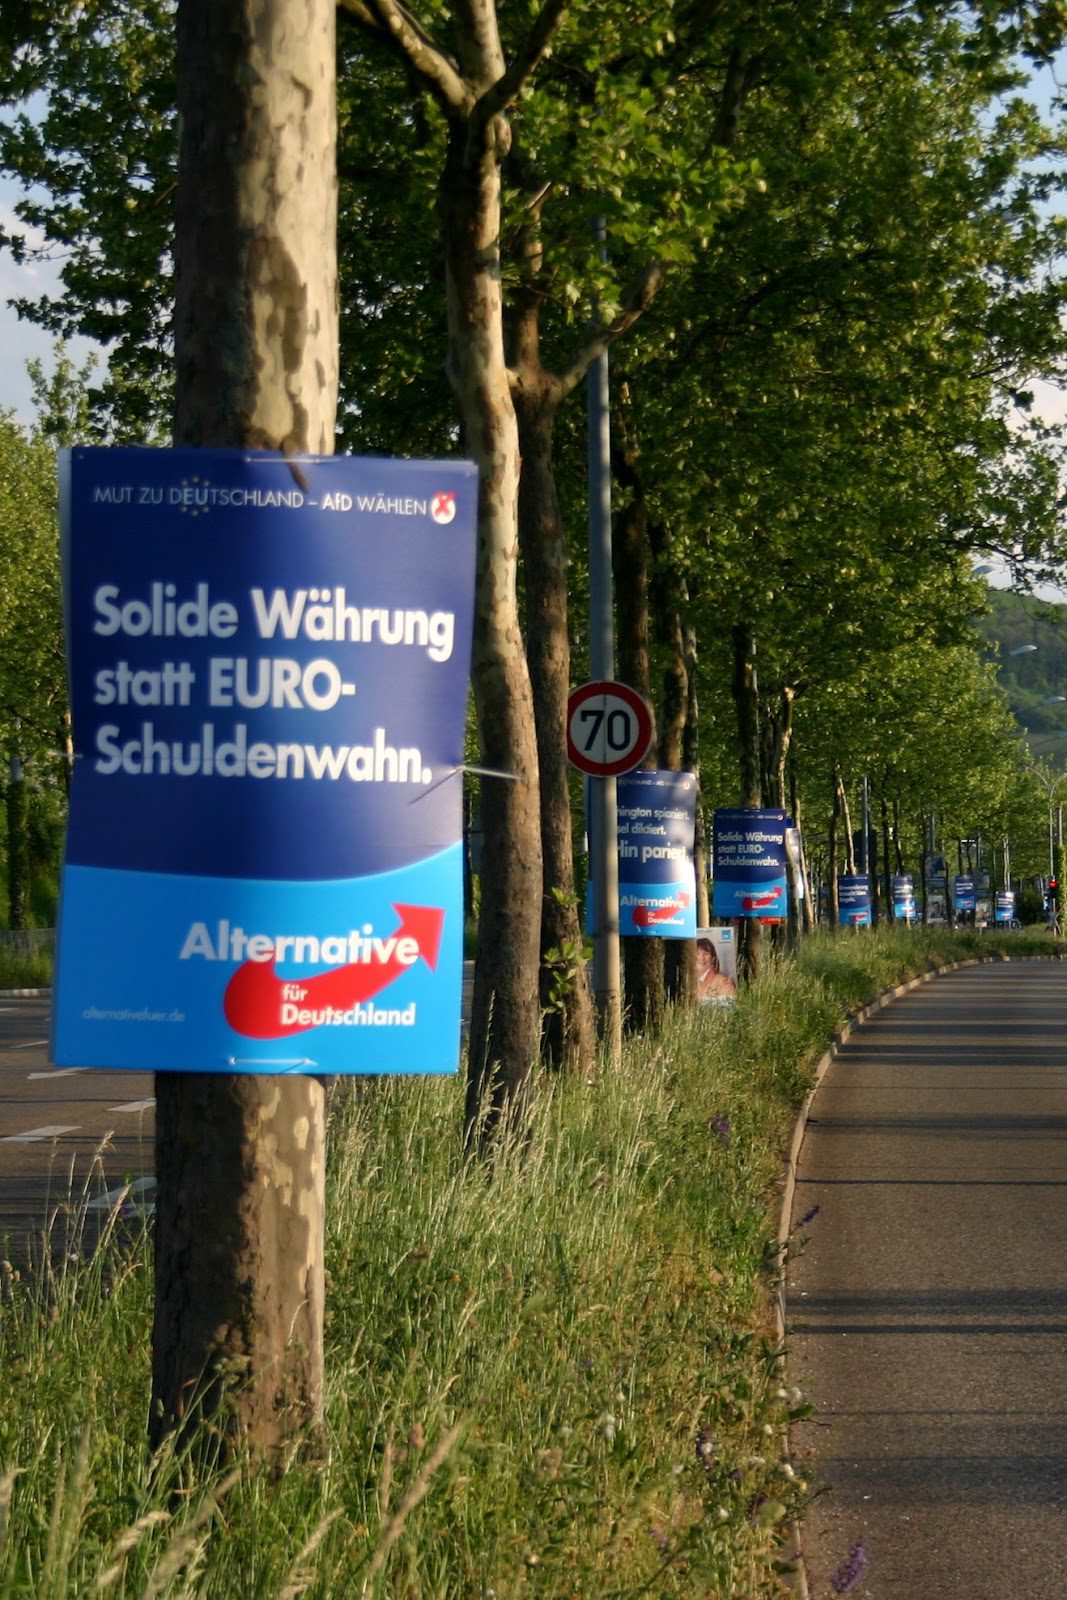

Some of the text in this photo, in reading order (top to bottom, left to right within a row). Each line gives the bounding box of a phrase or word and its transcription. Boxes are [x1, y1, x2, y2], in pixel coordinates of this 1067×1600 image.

[94, 487, 133, 503] MUT
[139, 487, 163, 504] ZU
[169, 487, 304, 508] DEUTSCHLAND
[322, 492, 353, 511] AfD
[357, 492, 426, 516] WÄHLEN
[94, 583, 455, 663] Solide Währung
[94, 657, 356, 711] statt EURO-
[580, 709, 631, 751] 70
[94, 722, 433, 785] Schuldenwahn.
[617, 806, 652, 820] hington
[617, 822, 629, 834] sel
[717, 831, 784, 845] Solide Währung
[618, 840, 639, 858] lin
[738, 844, 765, 854] EURO-
[718, 856, 780, 867] Schuldenwahn.
[620, 895, 685, 909] Alternative
[734, 889, 779, 899] Alternative
[179, 919, 420, 965] Alternative
[281, 984, 308, 1001] für
[82, 1005, 186, 1022] alternativefuer.de
[281, 1002, 416, 1027] Deutschland
